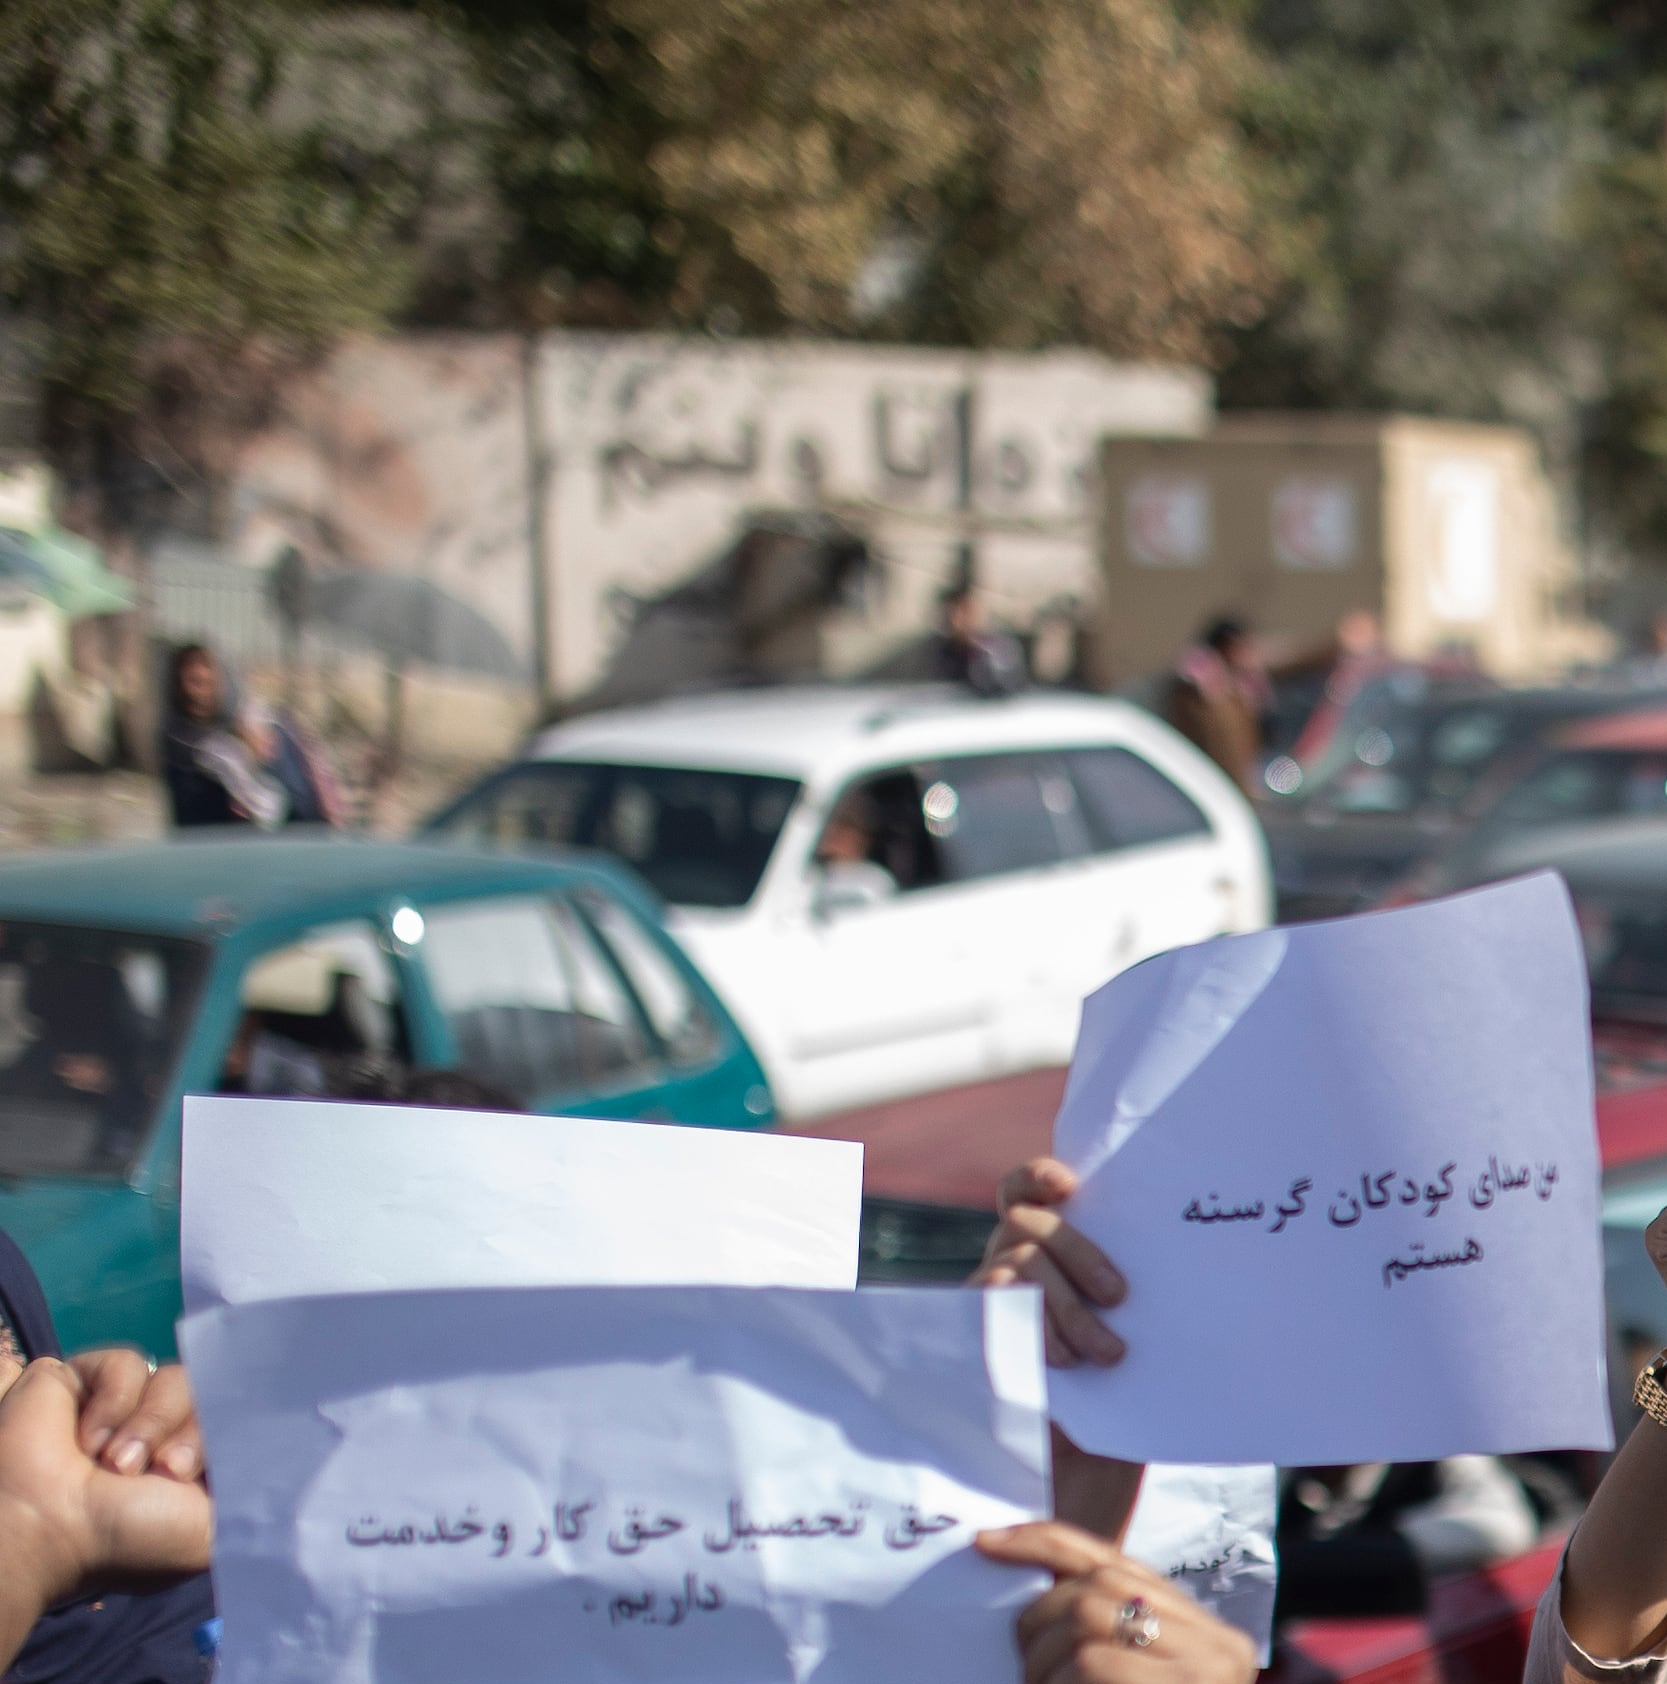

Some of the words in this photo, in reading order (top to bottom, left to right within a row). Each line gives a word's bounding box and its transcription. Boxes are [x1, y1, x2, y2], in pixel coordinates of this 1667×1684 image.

[1180, 1176, 1313, 1234] گرسنه
[1328, 1161, 1457, 1229] کودکان
[1468, 1154, 1531, 1210] صدای
[1382, 1237, 1486, 1289] هستم
[529, 1500, 595, 1557] کار
[606, 1505, 684, 1555] حق
[703, 1498, 871, 1553] تحصیل
[883, 1503, 960, 1552] حق
